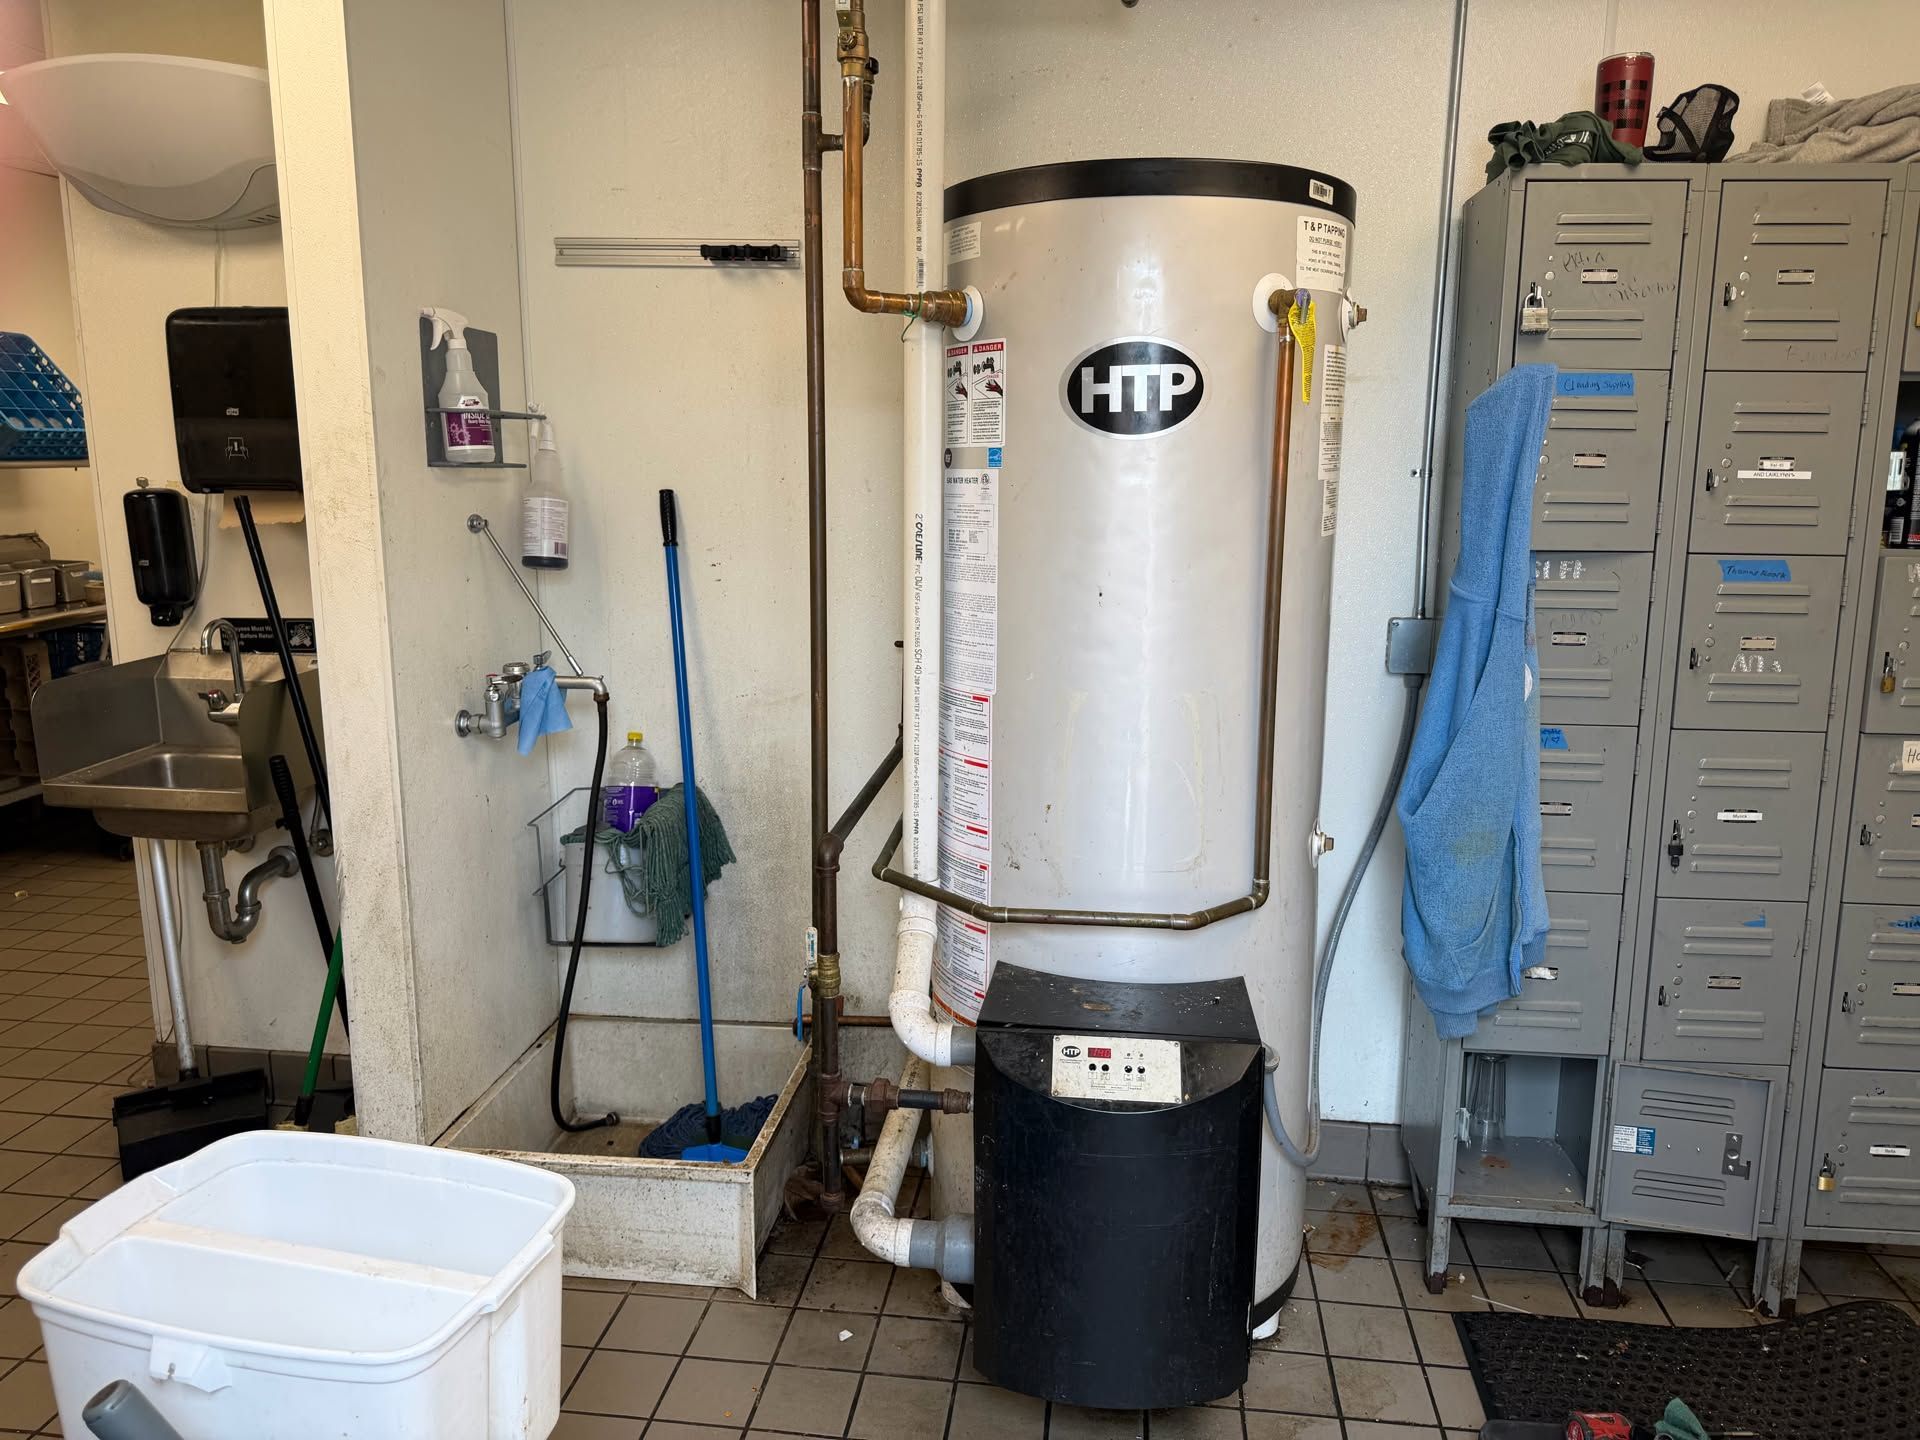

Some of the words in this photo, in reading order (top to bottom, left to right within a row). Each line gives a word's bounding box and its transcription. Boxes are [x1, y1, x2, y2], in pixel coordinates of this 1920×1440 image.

[1304, 220, 1309, 230] T
[1310, 222, 1316, 232] &
[1318, 222, 1323, 232] P
[1324, 224, 1346, 238] TAPPING
[979, 342, 1002, 351] DANGER
[1081, 363, 1197, 414] HTP
[914, 664, 922, 675] 40
[1063, 1048, 1080, 1056] HTP
